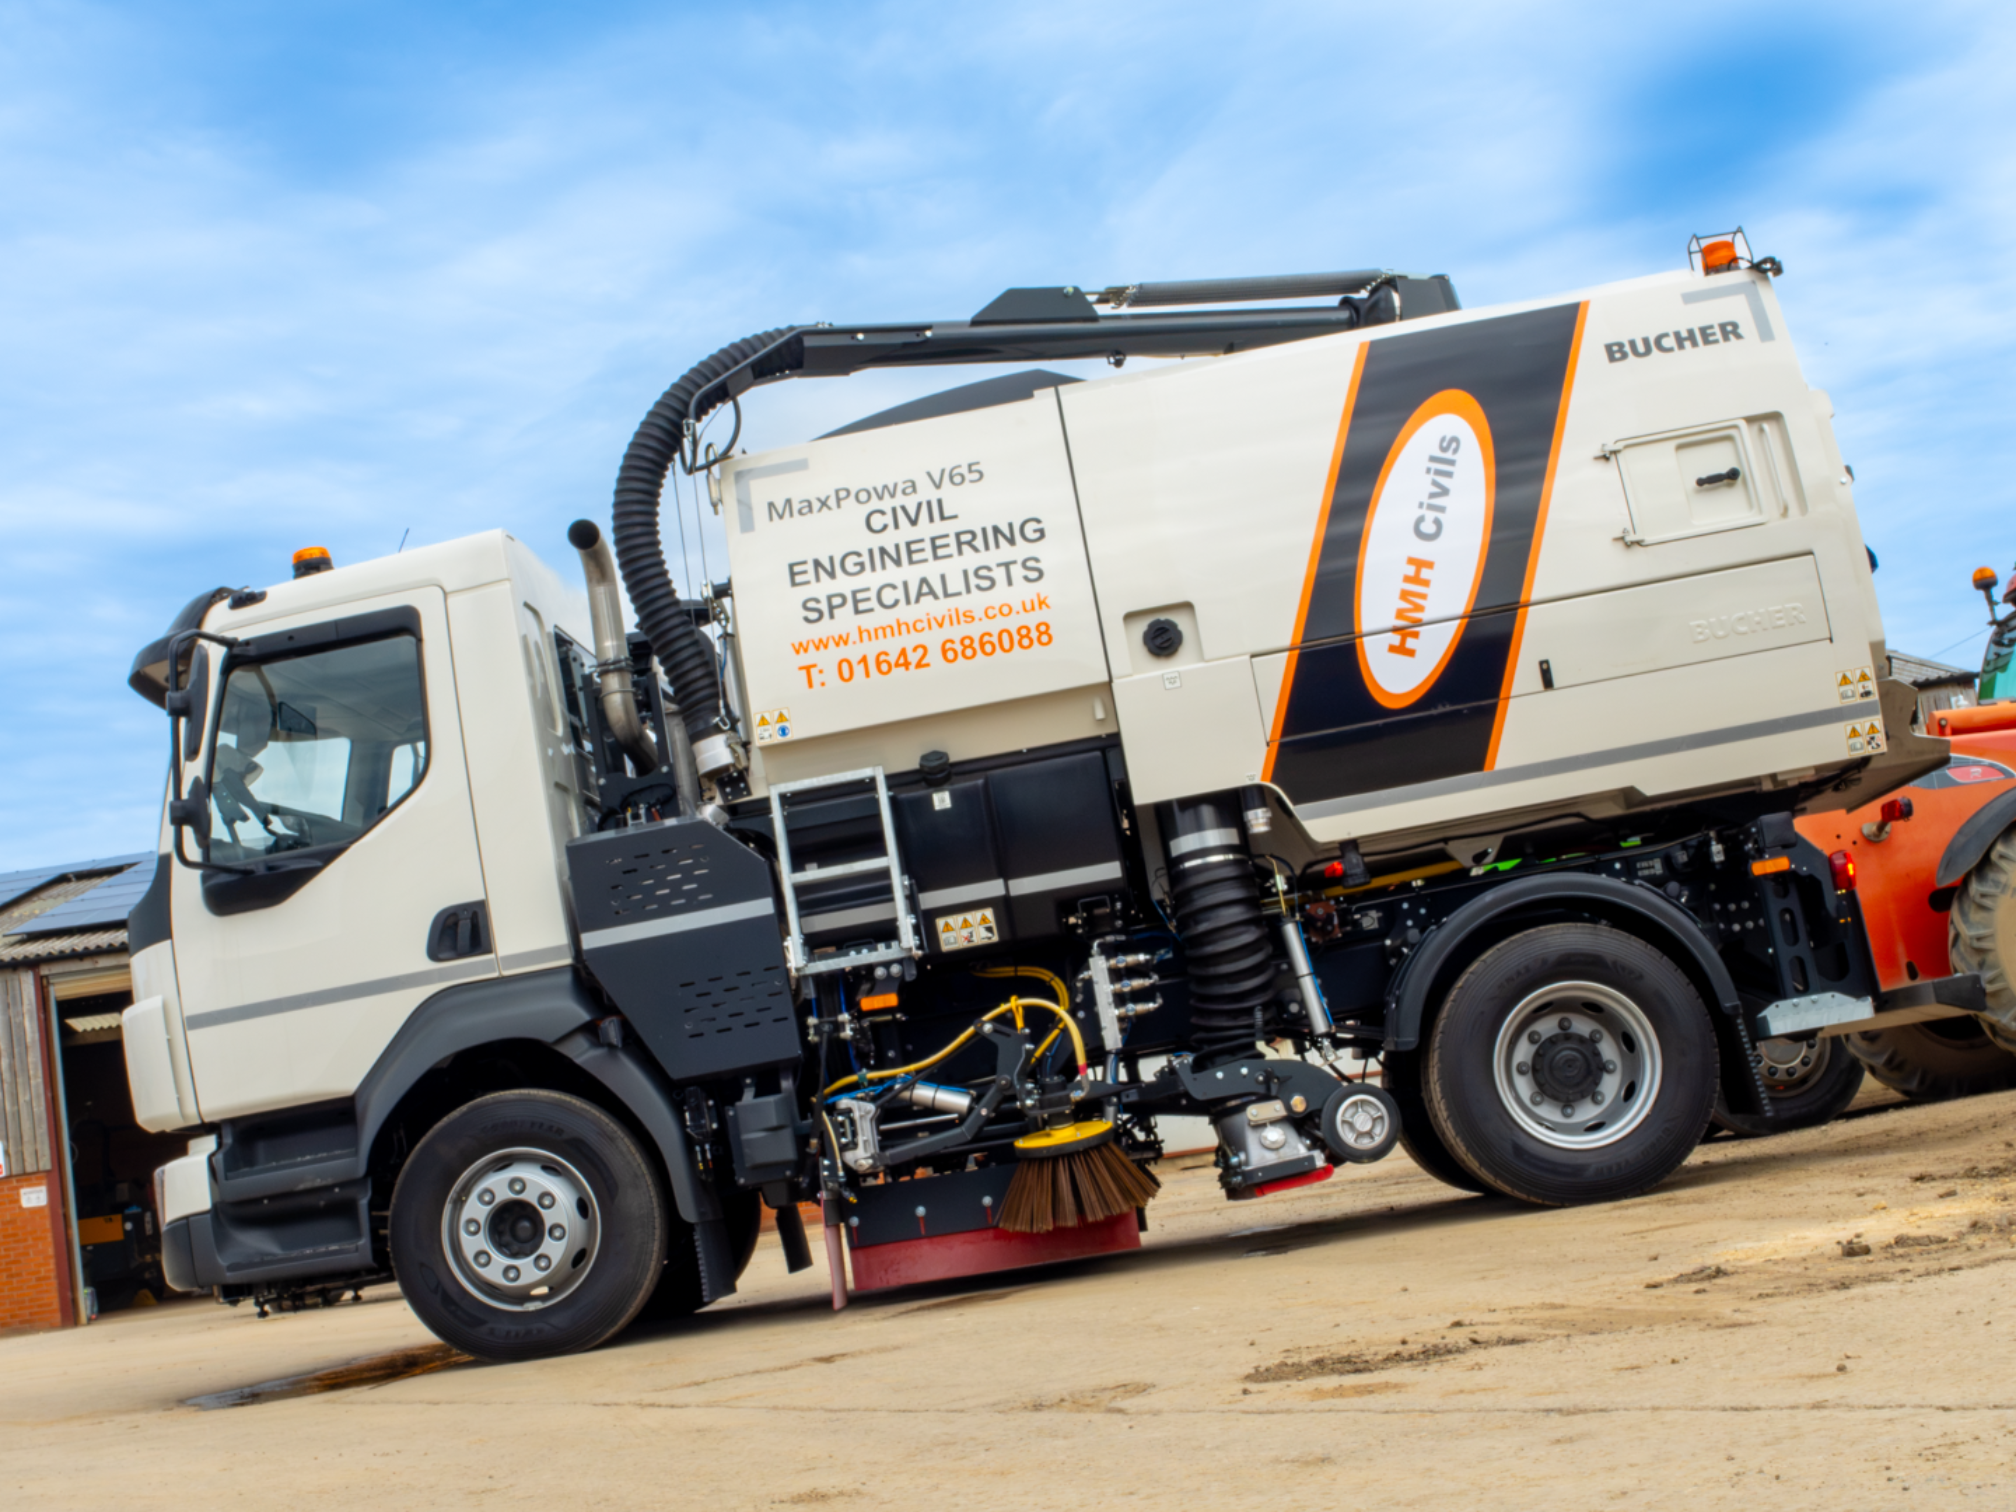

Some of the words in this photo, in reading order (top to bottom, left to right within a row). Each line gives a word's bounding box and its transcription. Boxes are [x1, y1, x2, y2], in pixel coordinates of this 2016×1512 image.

[1604, 320, 1744, 363] BUCHER
[767, 479, 918, 522] MaxPowa
[926, 461, 984, 489] V65
[864, 498, 959, 533] CIVIL
[787, 517, 1046, 588] ENGINEERING
[1388, 556, 1435, 658] HMH
[1413, 434, 1461, 541] Civils
[801, 556, 1045, 624] SPECIALISTS
[791, 592, 1051, 655] www.hmhcivils.co.uk
[1688, 602, 1807, 644] BUCHER
[798, 664, 826, 689] T:
[837, 644, 930, 683] 01642
[941, 622, 1054, 664] 686088
